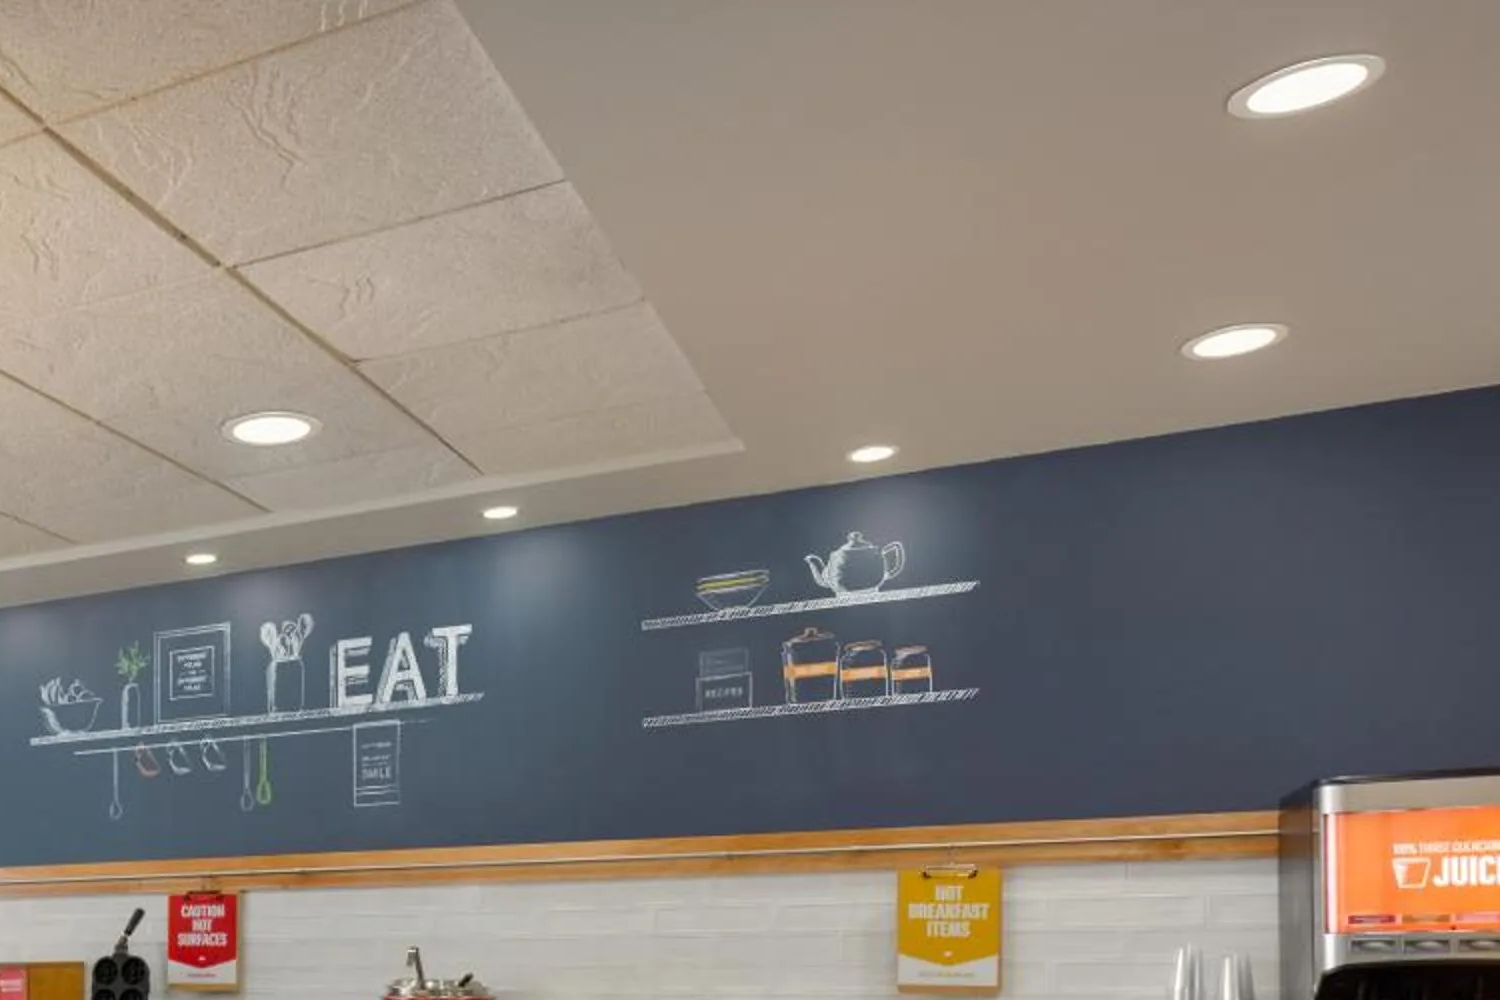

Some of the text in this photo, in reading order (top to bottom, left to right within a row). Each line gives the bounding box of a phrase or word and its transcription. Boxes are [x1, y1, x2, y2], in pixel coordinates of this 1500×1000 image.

[329, 624, 473, 706] EAT
[1432, 856, 1500, 887] JUIC
[181, 904, 225, 918] CAUTION
[907, 902, 990, 919] BREAKFAST
[926, 920, 971, 937] ITEMS
[177, 932, 228, 947] SURFACES
